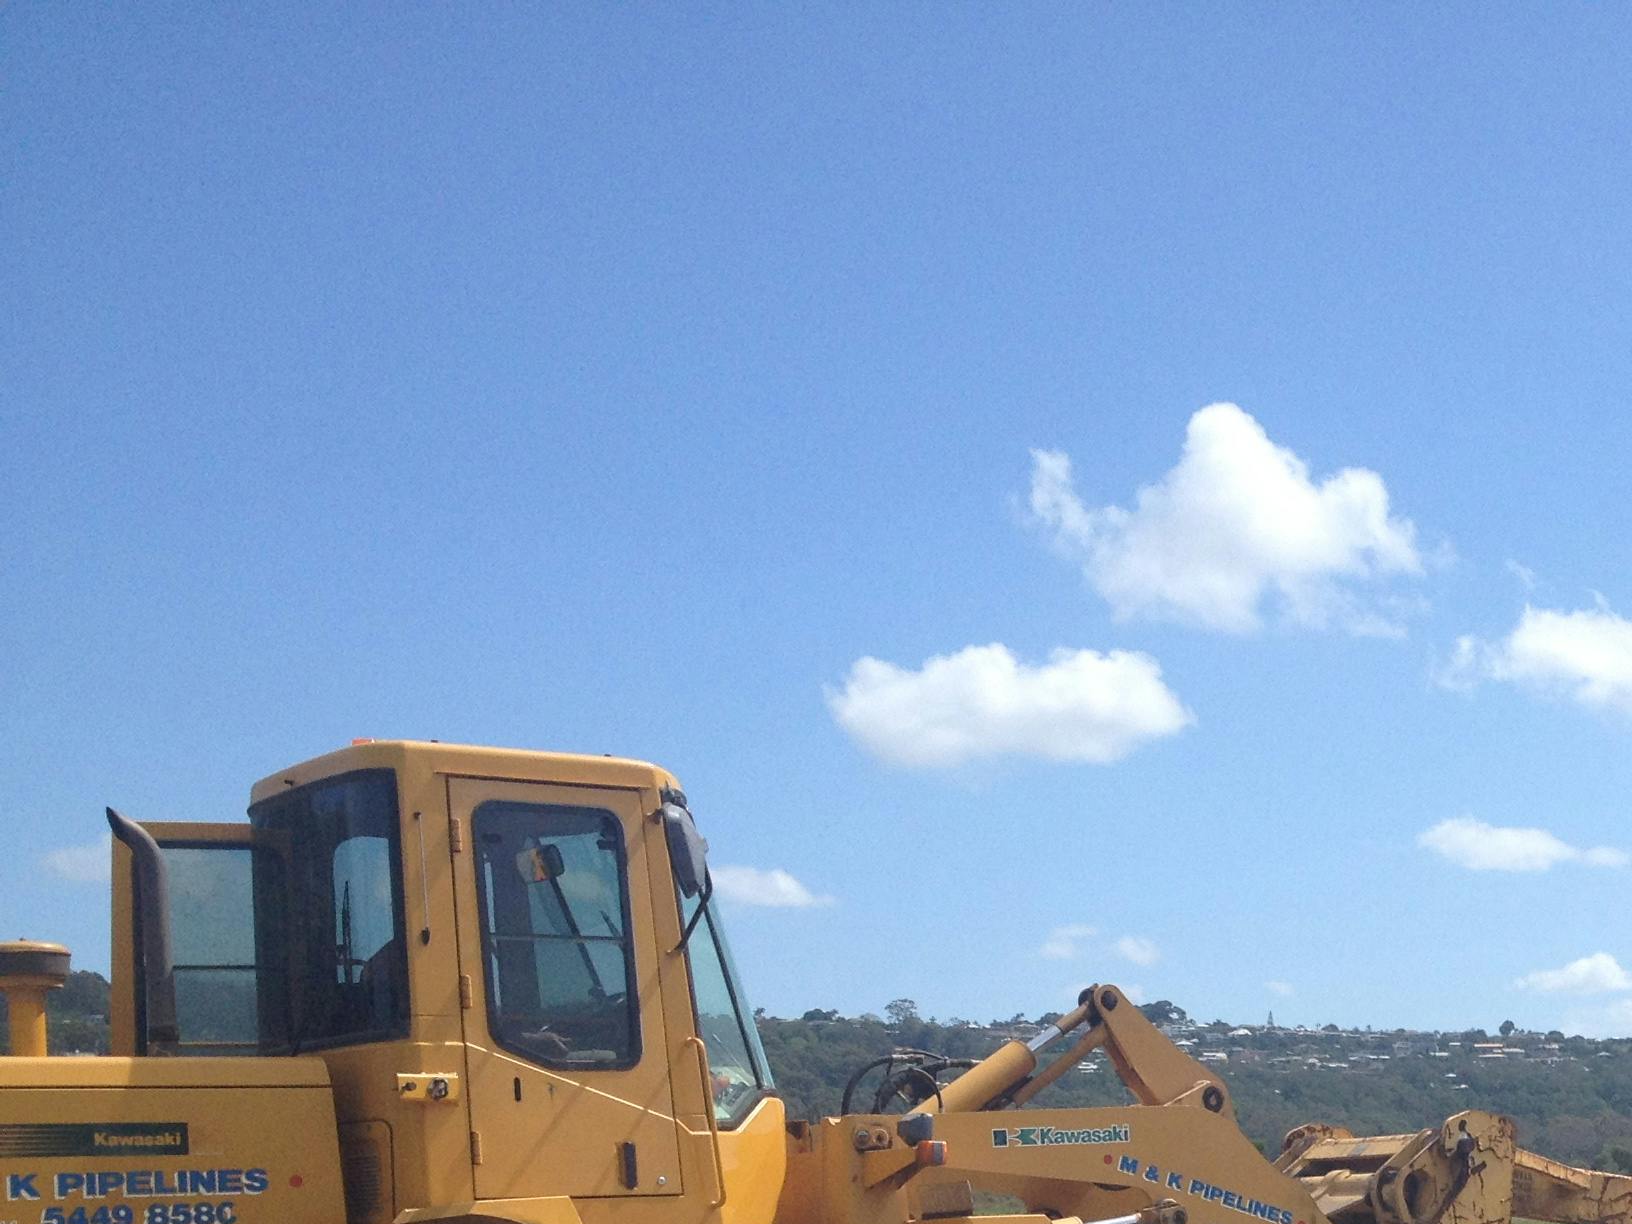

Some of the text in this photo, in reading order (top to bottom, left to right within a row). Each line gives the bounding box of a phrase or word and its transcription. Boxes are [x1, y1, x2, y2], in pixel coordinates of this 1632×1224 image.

[94, 1132, 181, 1148] Kawasaki
[1039, 1123, 1130, 1146] Kawasaki
[6, 1168, 270, 1201] K PIPELINES
[1118, 1155, 1139, 1176] M
[1142, 1165, 1160, 1184] &
[1165, 1171, 1184, 1192] K
